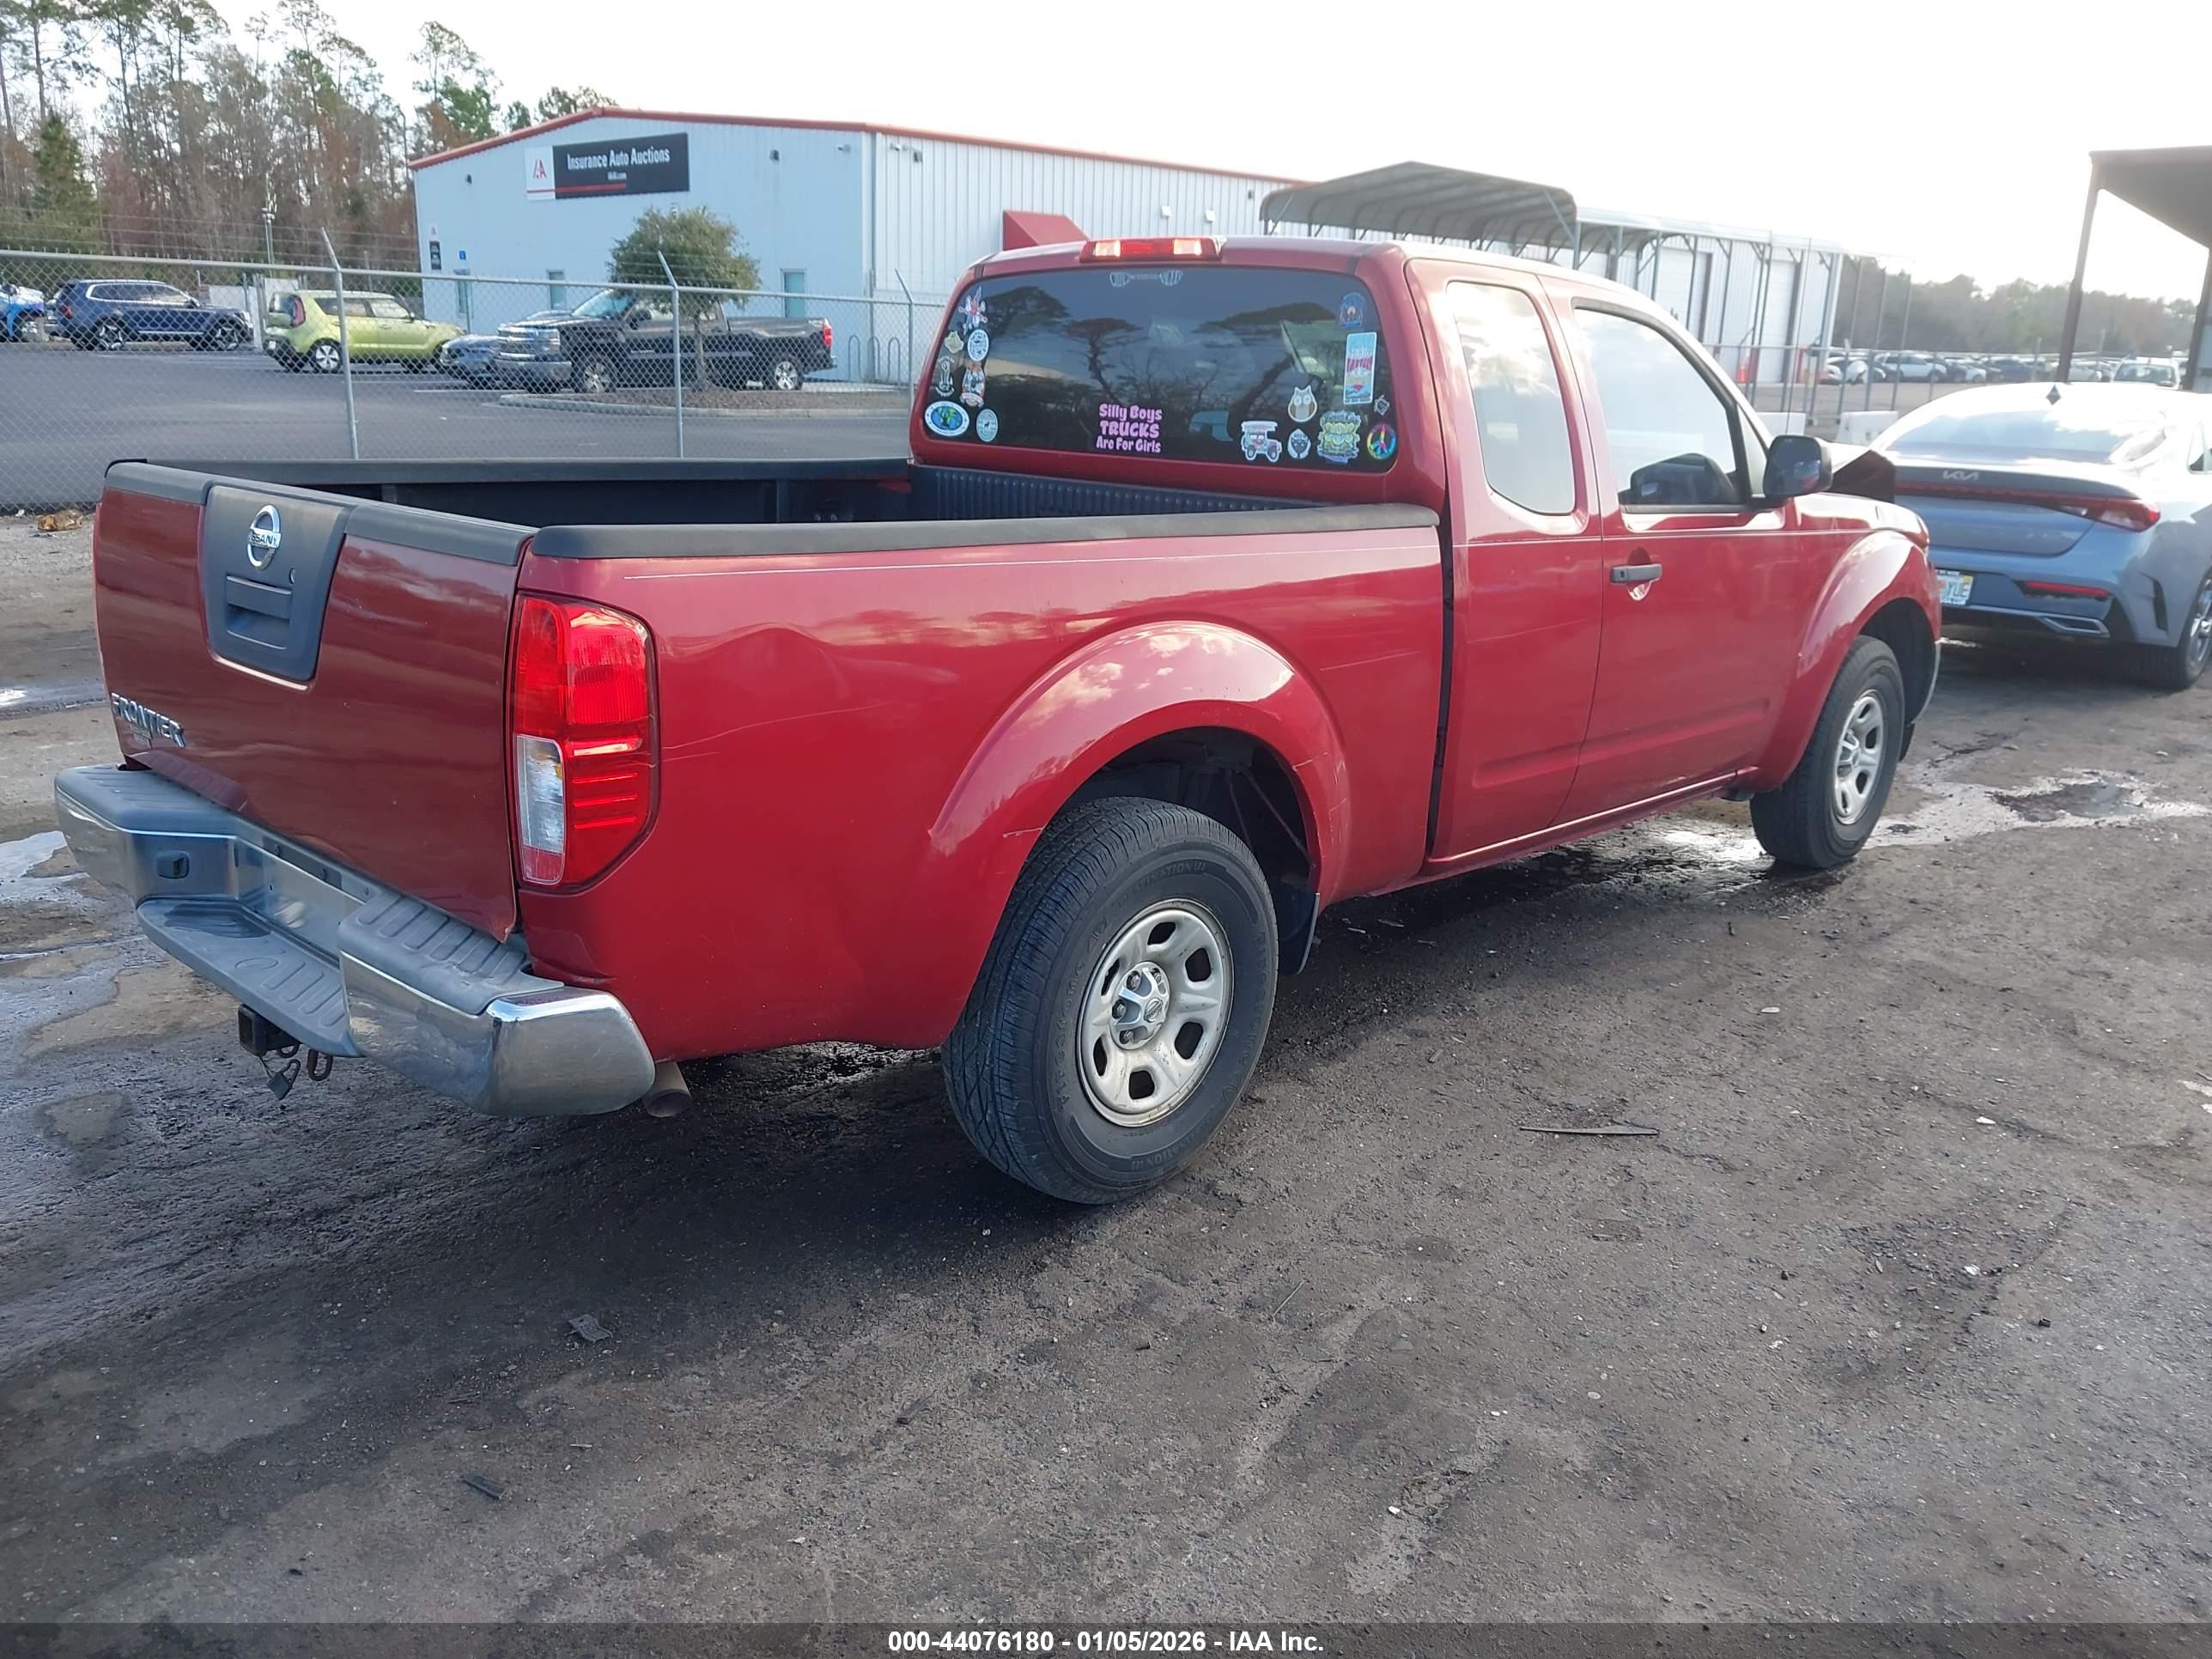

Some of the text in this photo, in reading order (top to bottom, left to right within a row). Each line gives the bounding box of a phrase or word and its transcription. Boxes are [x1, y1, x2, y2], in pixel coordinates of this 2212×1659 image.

[567, 146, 670, 170] Insurance Auto Auctions
[1099, 404, 1163, 423] Silly Boys
[1100, 420, 1159, 439] TRUCKS
[1115, 436, 1134, 451] For
[1135, 438, 1162, 453] Girls
[248, 532, 275, 545] SSAN
[111, 692, 185, 748] FRONTIER
